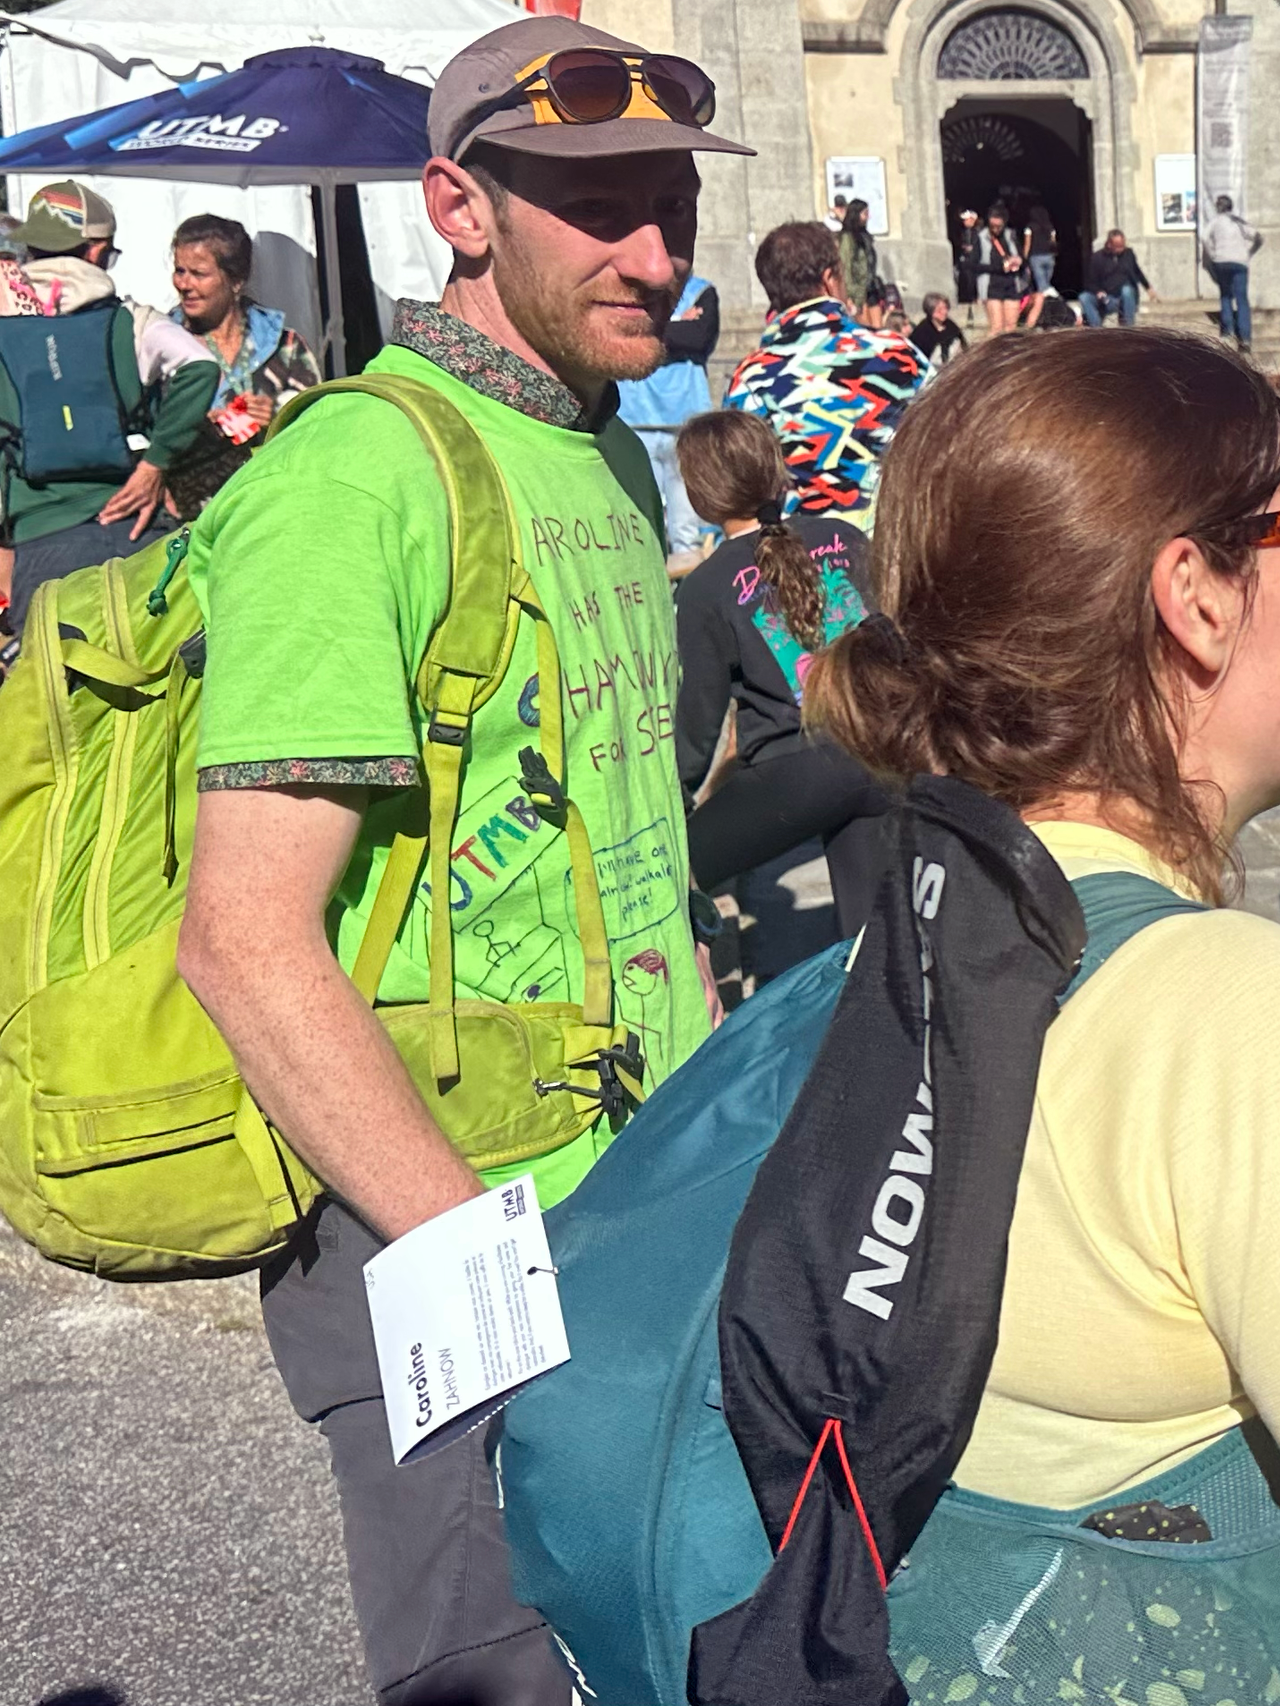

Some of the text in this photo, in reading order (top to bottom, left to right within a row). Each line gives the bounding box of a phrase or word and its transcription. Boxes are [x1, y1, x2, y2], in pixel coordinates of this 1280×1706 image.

[137, 114, 280, 139] UTMB
[569, 582, 643, 633] HAS THE
[842, 856, 946, 1321] SMON
[501, 1188, 519, 1222] UTMB
[407, 1342, 433, 1428] Caroline
[438, 1347, 461, 1411] ZAHNOW
